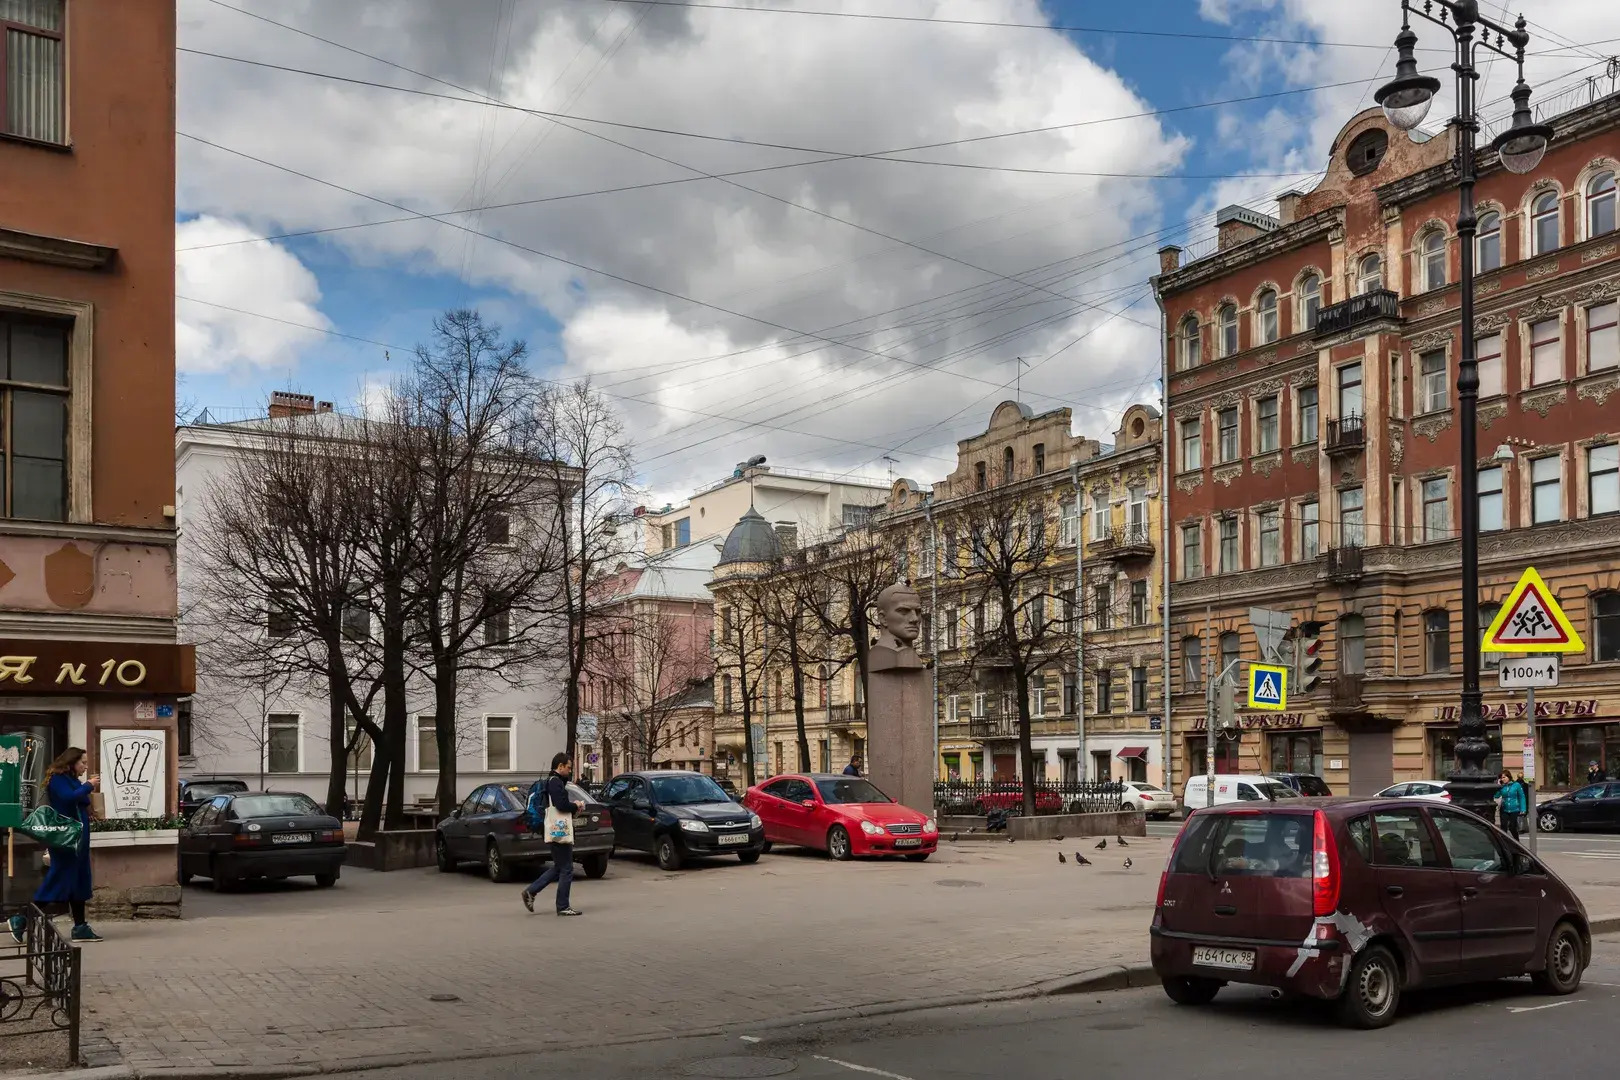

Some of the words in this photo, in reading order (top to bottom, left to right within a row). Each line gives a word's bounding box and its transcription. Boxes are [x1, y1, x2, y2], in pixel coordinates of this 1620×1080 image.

[98, 658, 147, 687] 10
[1441, 699, 1598, 720] ПОДУКТЫ
[1194, 713, 1304, 730] ПУКТЫ
[1240, 951, 1252, 962] 98
